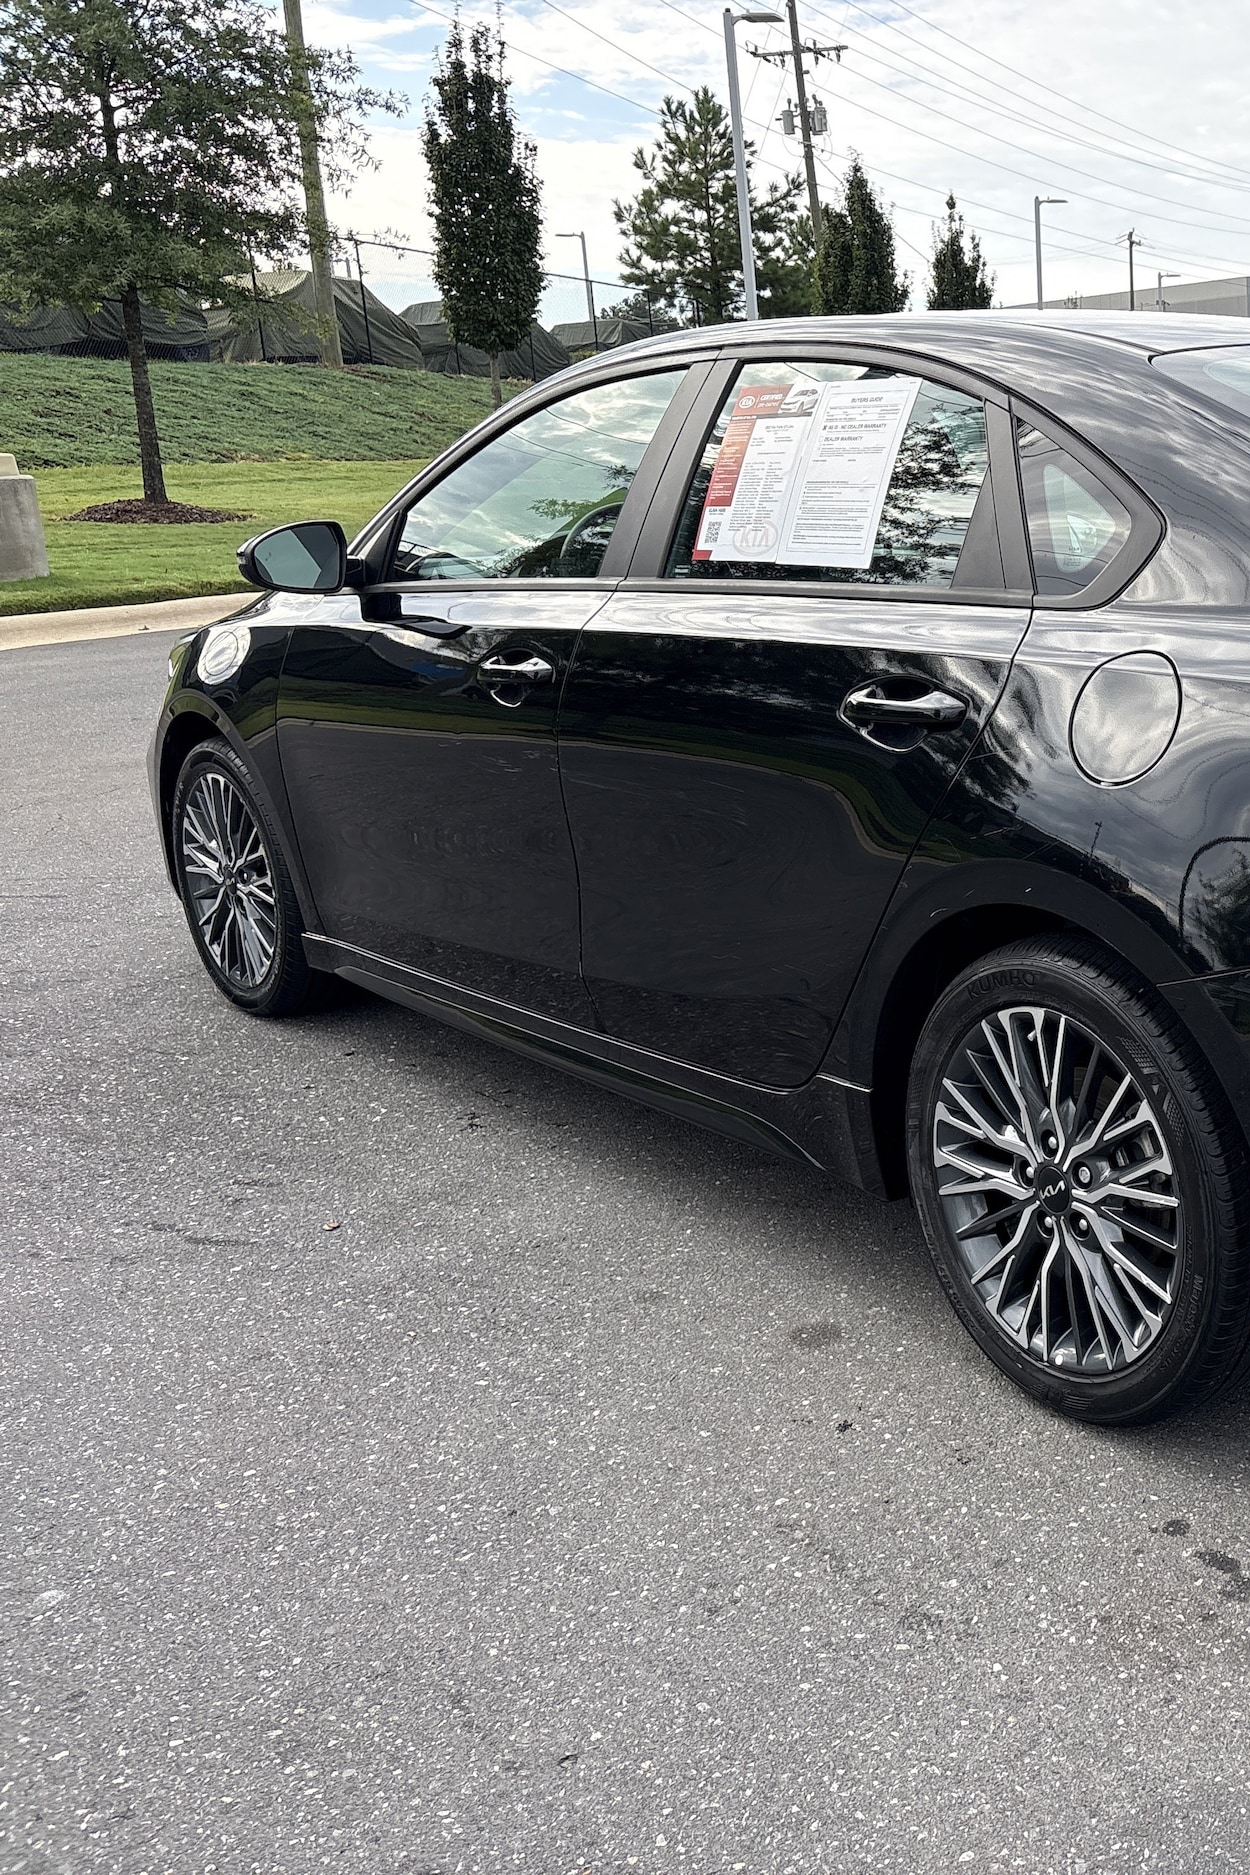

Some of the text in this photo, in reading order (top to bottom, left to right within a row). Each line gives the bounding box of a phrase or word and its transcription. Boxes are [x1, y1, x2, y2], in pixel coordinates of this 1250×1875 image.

[739, 527, 769, 547] KIA
[966, 969, 1035, 1000] KUMHO
[1040, 1180, 1066, 1199] KIA
